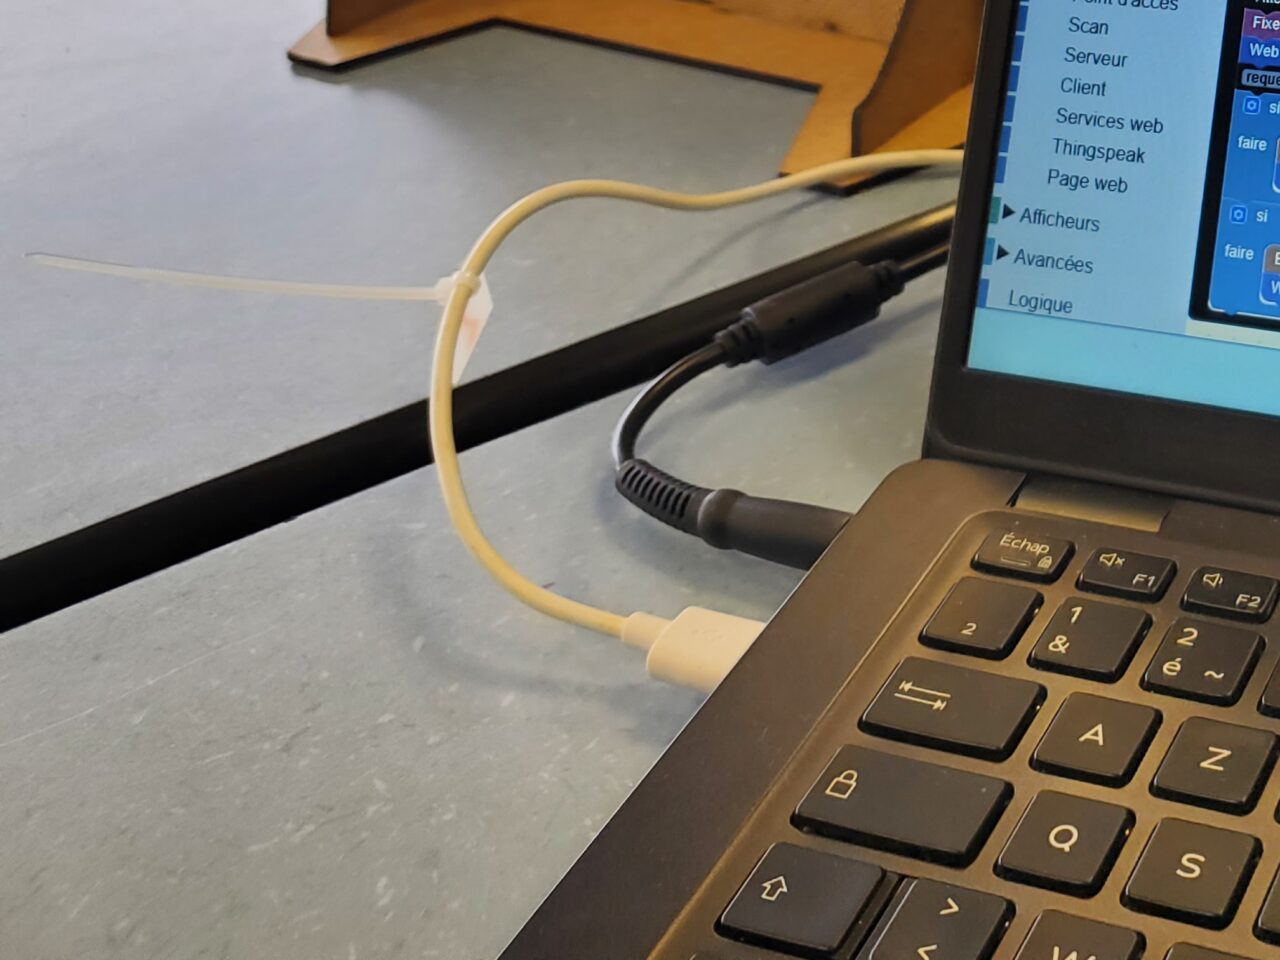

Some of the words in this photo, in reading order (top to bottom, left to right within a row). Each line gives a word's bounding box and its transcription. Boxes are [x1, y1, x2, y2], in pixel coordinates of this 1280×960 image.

[1069, 17, 1109, 35] Scan
[1065, 47, 1128, 67] Serveur
[1250, 43, 1278, 58] Web
[1061, 77, 1106, 96] Client
[1056, 108, 1124, 130] Services
[1130, 117, 1164, 134] web
[1053, 138, 1146, 164] Thingspeak
[1238, 135, 1267, 151] faire
[1048, 169, 1089, 191] Page
[1020, 208, 1100, 232] Afficheurs
[1014, 249, 1093, 274] Avancées
[1009, 290, 1073, 314] Logique
[1000, 533, 1050, 555] Échap
[1132, 573, 1155, 587] F1
[1079, 723, 1104, 746] A
[1199, 746, 1232, 771] Z
